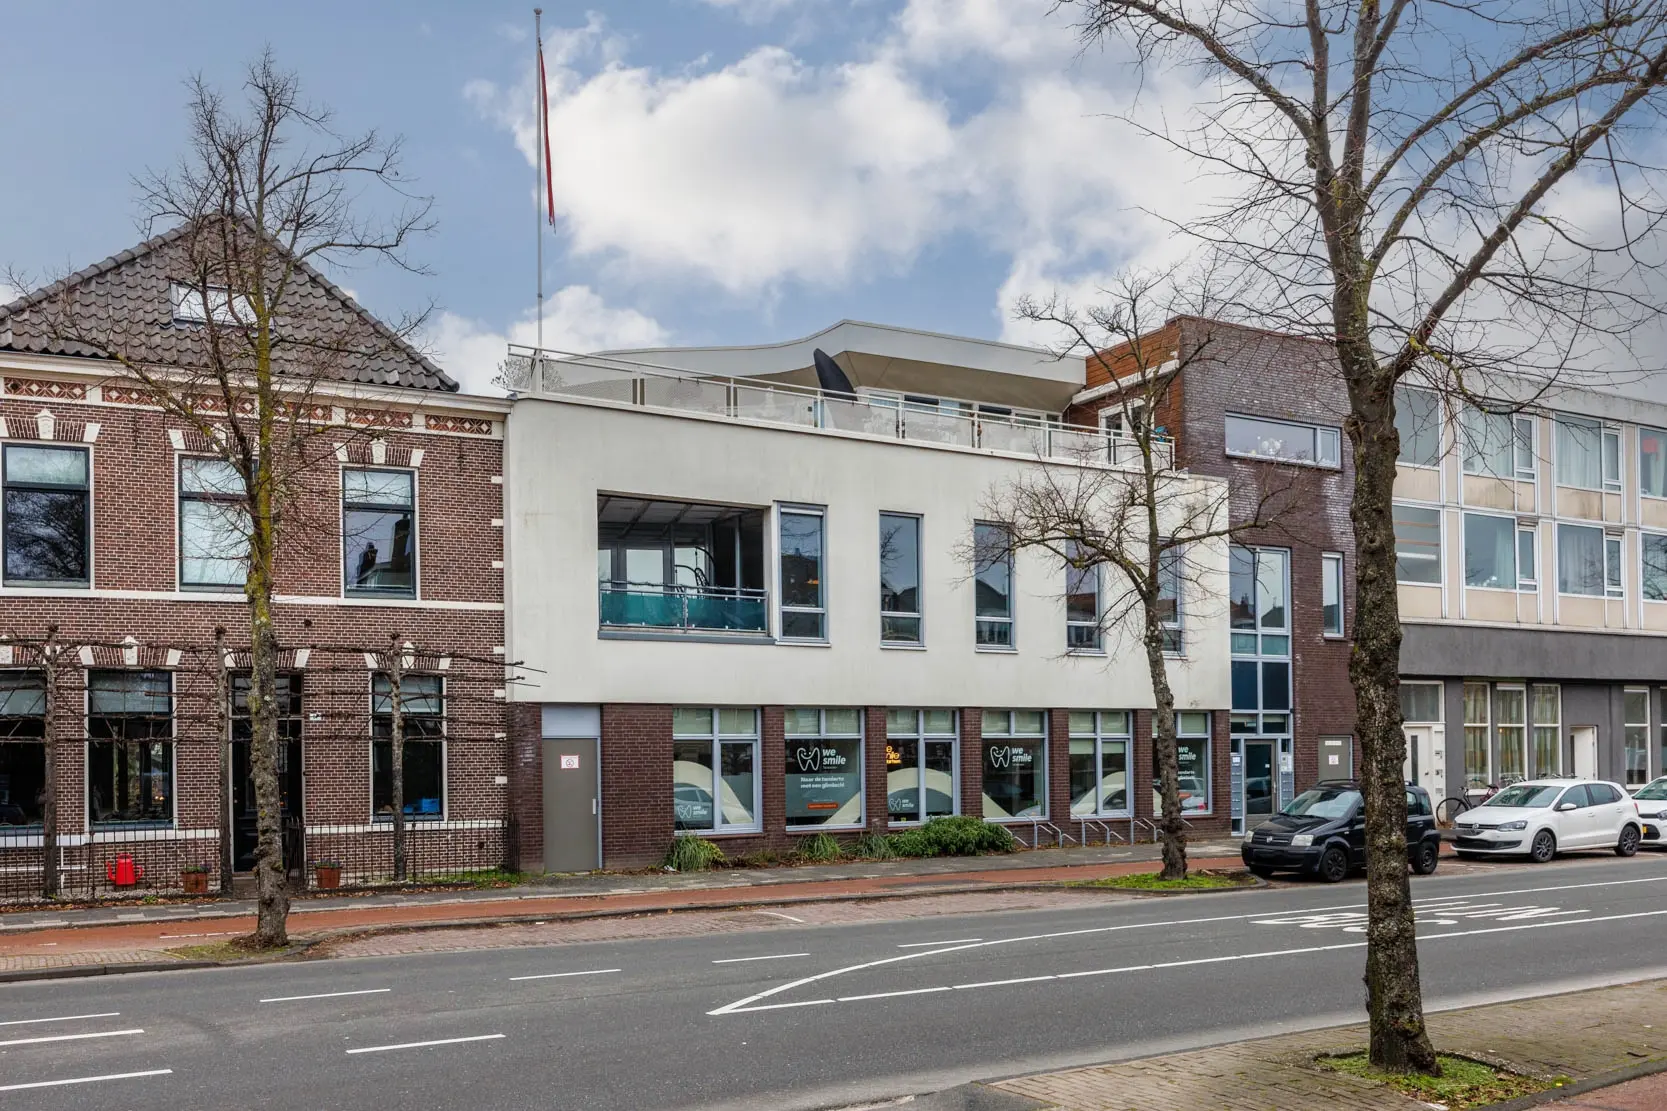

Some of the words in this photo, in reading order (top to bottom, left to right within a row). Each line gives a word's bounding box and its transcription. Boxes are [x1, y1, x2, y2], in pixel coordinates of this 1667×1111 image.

[823, 756, 846, 764] smile
[1012, 753, 1032, 762] smile
[1179, 752, 1196, 760] smile
